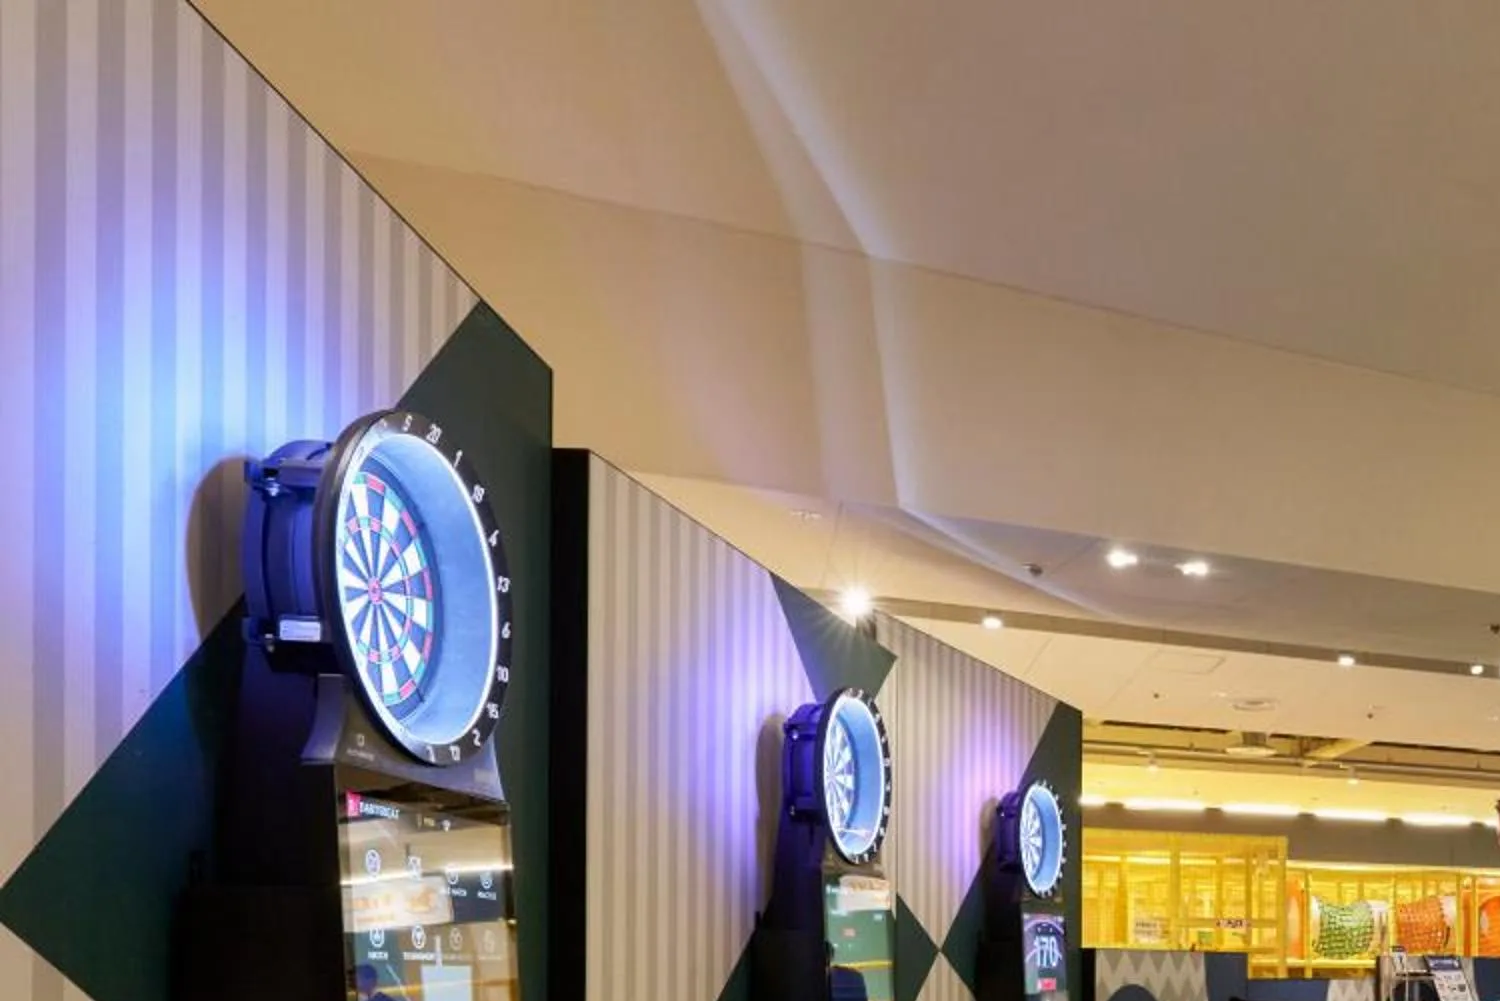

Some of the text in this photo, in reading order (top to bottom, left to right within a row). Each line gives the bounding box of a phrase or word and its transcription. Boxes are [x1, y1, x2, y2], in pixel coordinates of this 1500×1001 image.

[426, 423, 442, 444] 20
[453, 449, 463, 468] 1
[472, 484, 485, 504] 18
[487, 529, 500, 547] 4
[497, 575, 511, 593] 13
[501, 621, 511, 639] 6
[496, 665, 509, 682] 10
[486, 702, 499, 719] 15
[472, 728, 481, 747] 2
